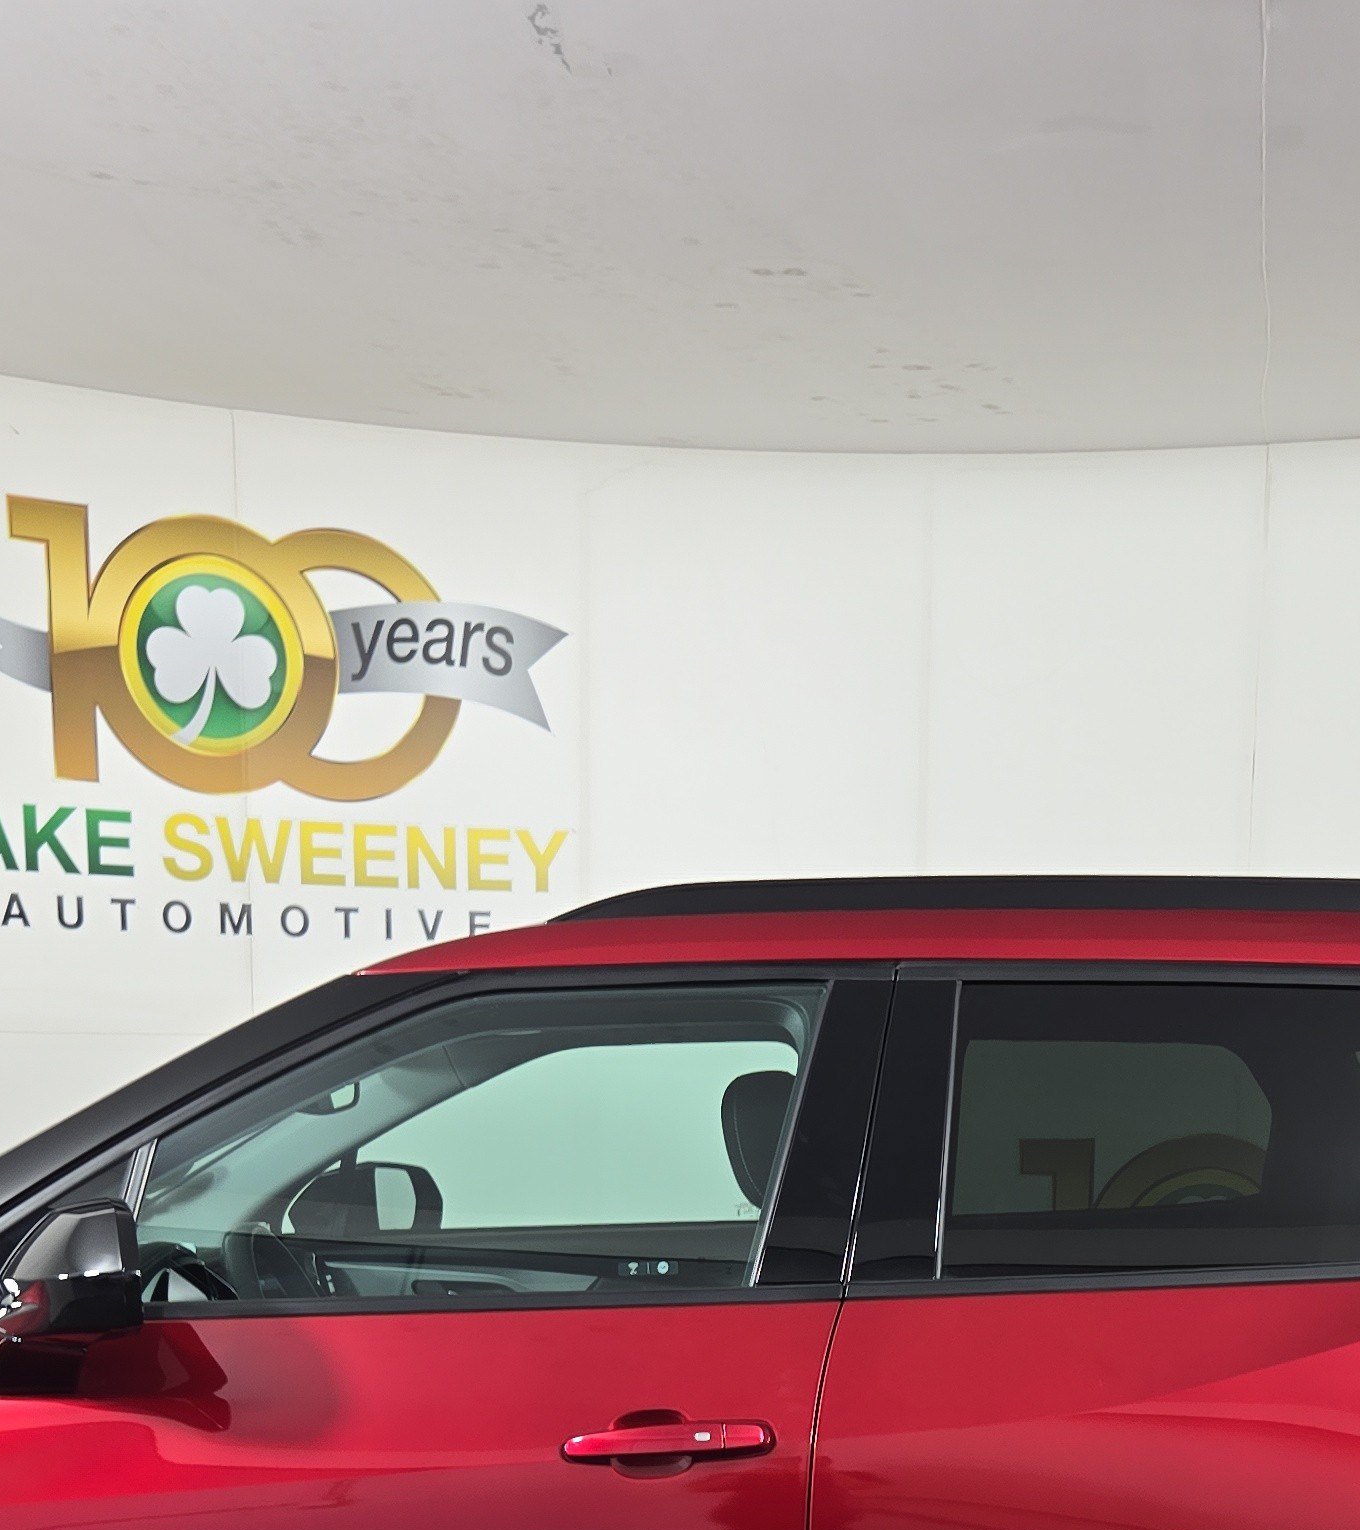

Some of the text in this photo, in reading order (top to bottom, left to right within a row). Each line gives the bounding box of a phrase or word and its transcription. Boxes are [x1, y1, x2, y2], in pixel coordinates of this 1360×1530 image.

[6, 493, 462, 803] 100
[351, 615, 515, 681] years
[162, 813, 568, 893] SWEENEY
[1, 892, 491, 941] AUTOMOTIVE
